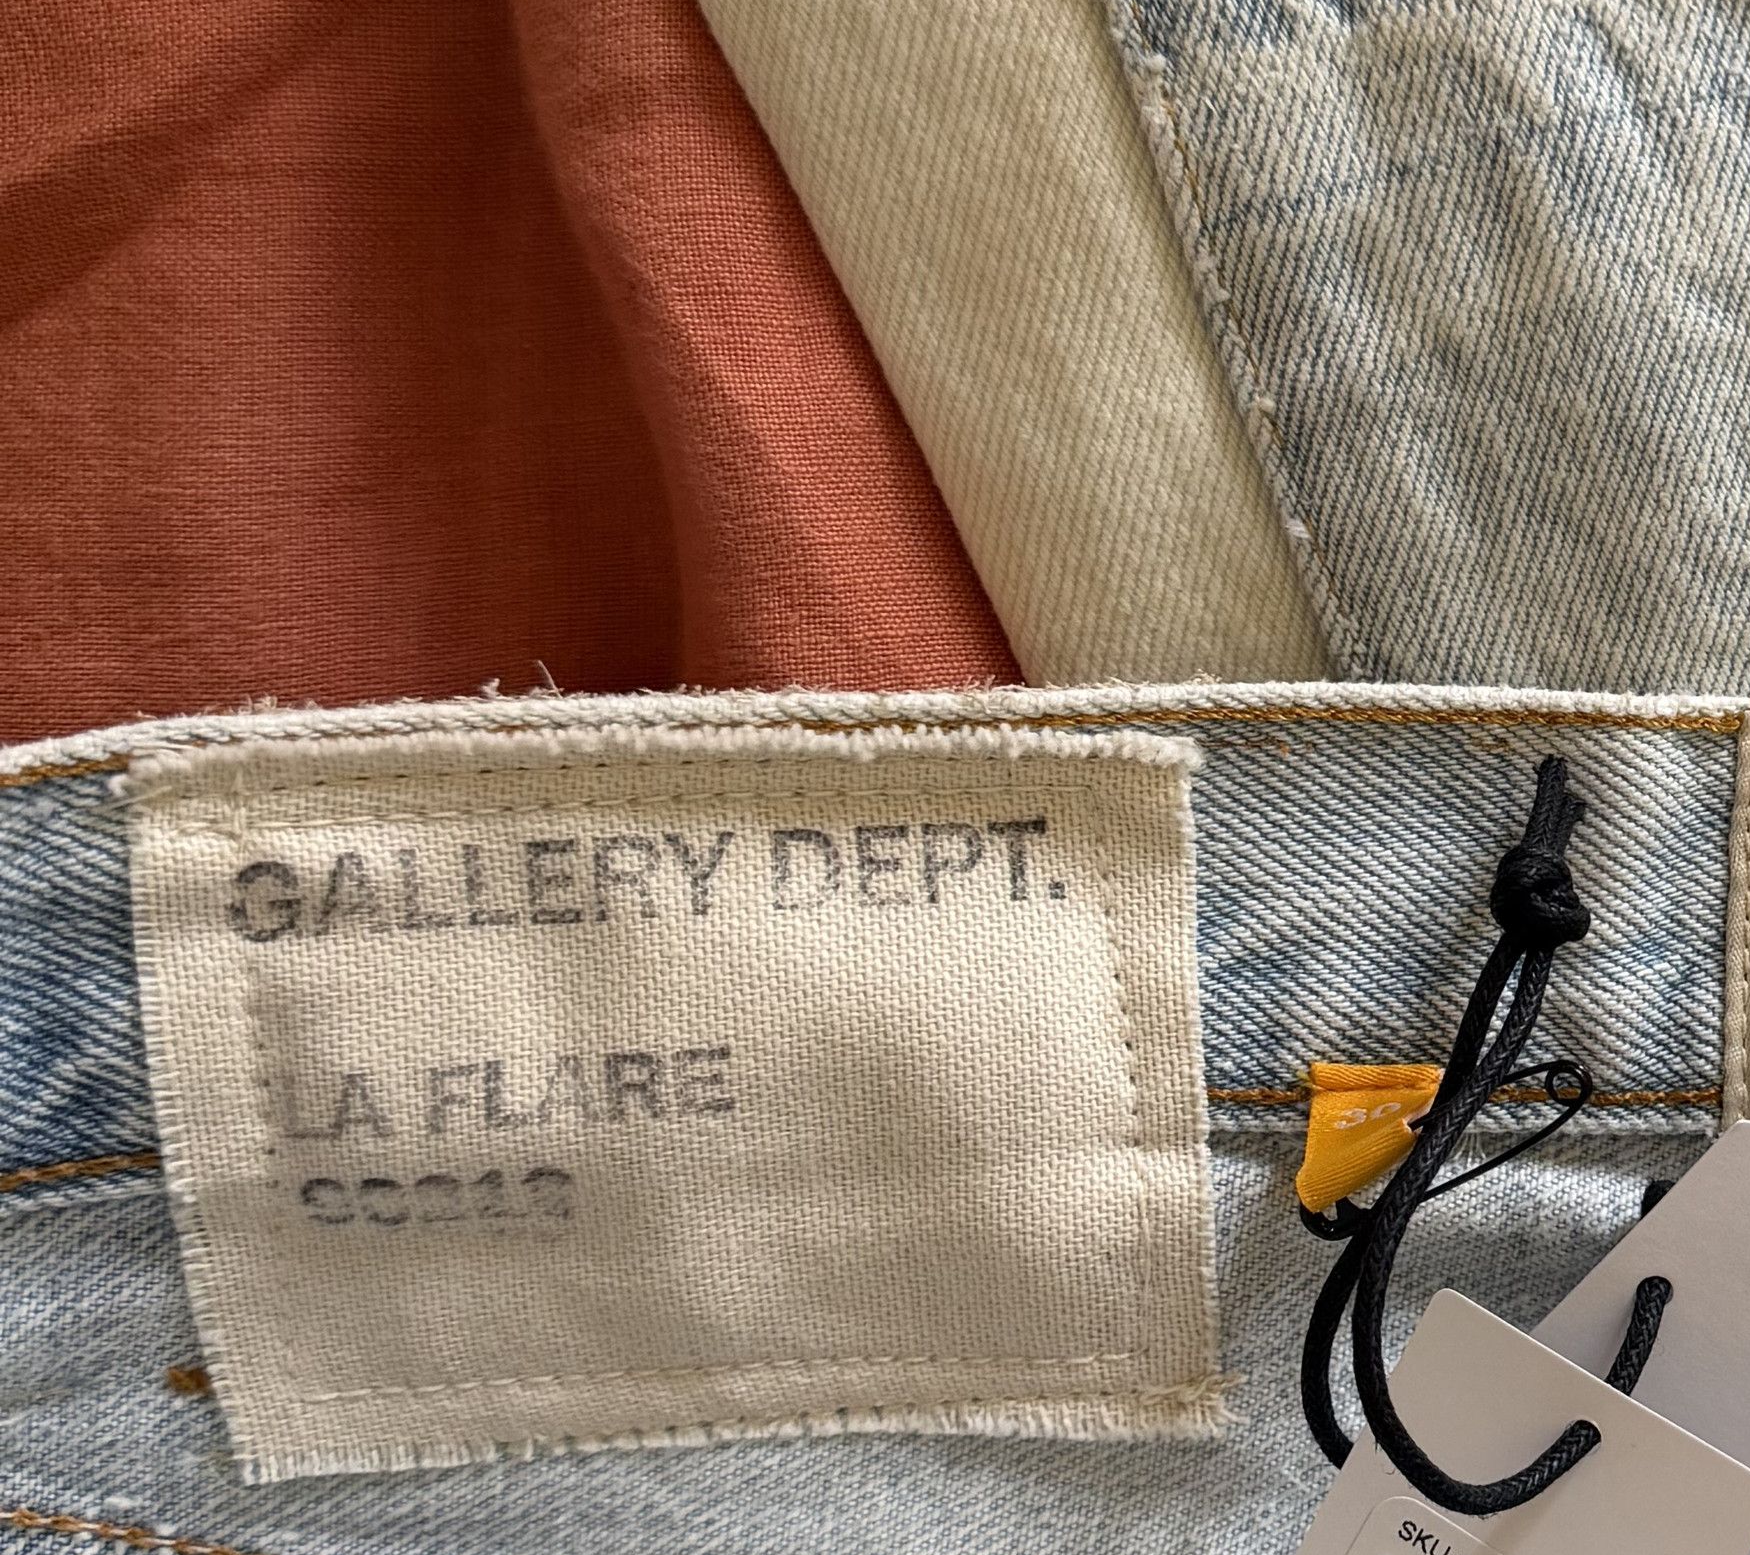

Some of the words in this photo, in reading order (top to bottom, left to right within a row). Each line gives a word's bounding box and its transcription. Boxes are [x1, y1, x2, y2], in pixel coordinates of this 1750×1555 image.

[228, 830, 735, 943] GALLERY
[770, 815, 1066, 911] DEPT.
[428, 1044, 735, 1136] FLARE
